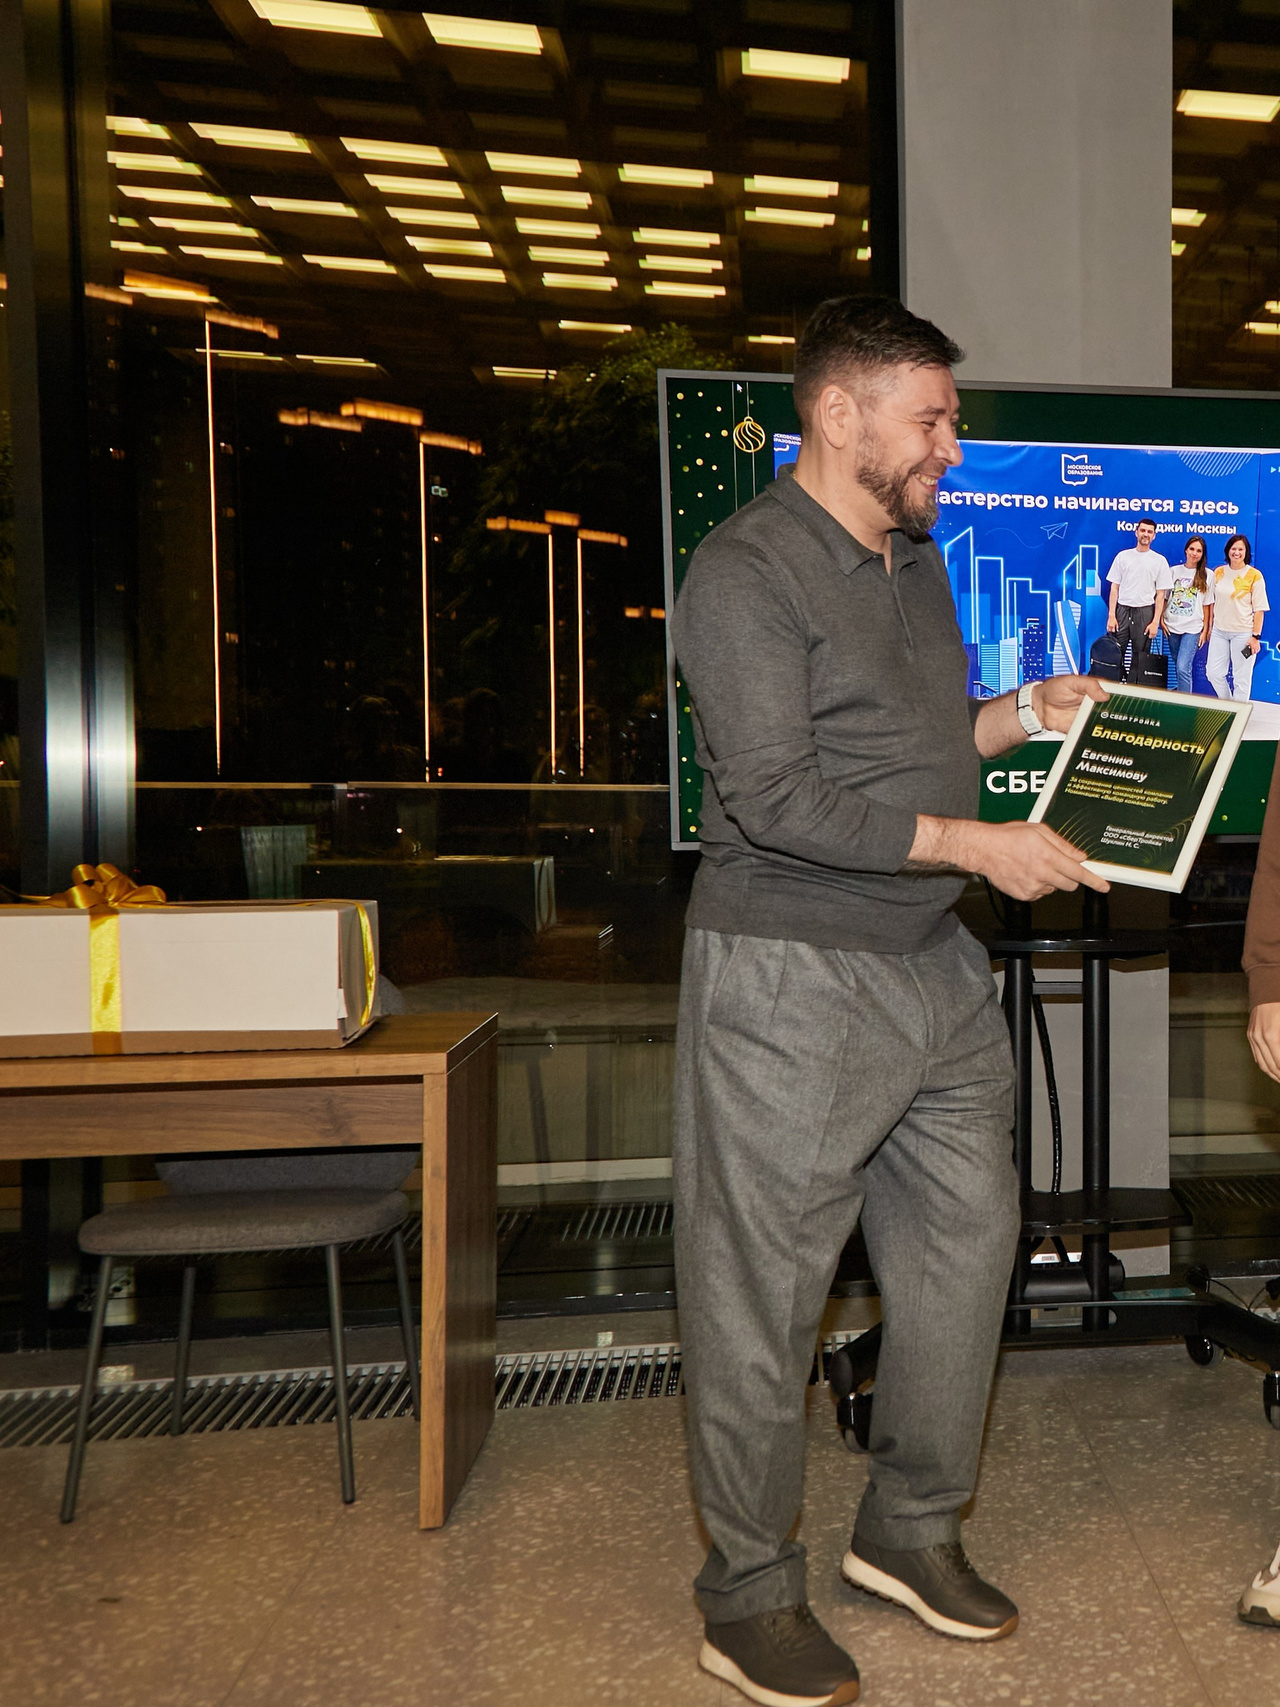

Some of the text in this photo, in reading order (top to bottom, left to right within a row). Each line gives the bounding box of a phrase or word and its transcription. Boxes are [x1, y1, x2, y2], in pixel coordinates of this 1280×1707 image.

[935, 490, 1239, 515] астерство начинается здесь
[1116, 520, 1237, 535] Колджи Москвы
[1091, 724, 1205, 755] Благодарность
[1081, 748, 1134, 767] Евгению
[1075, 761, 1148, 783] Максимову
[1103, 831, 1119, 839] ООО
[1105, 825, 1174, 842] Генеральный директор
